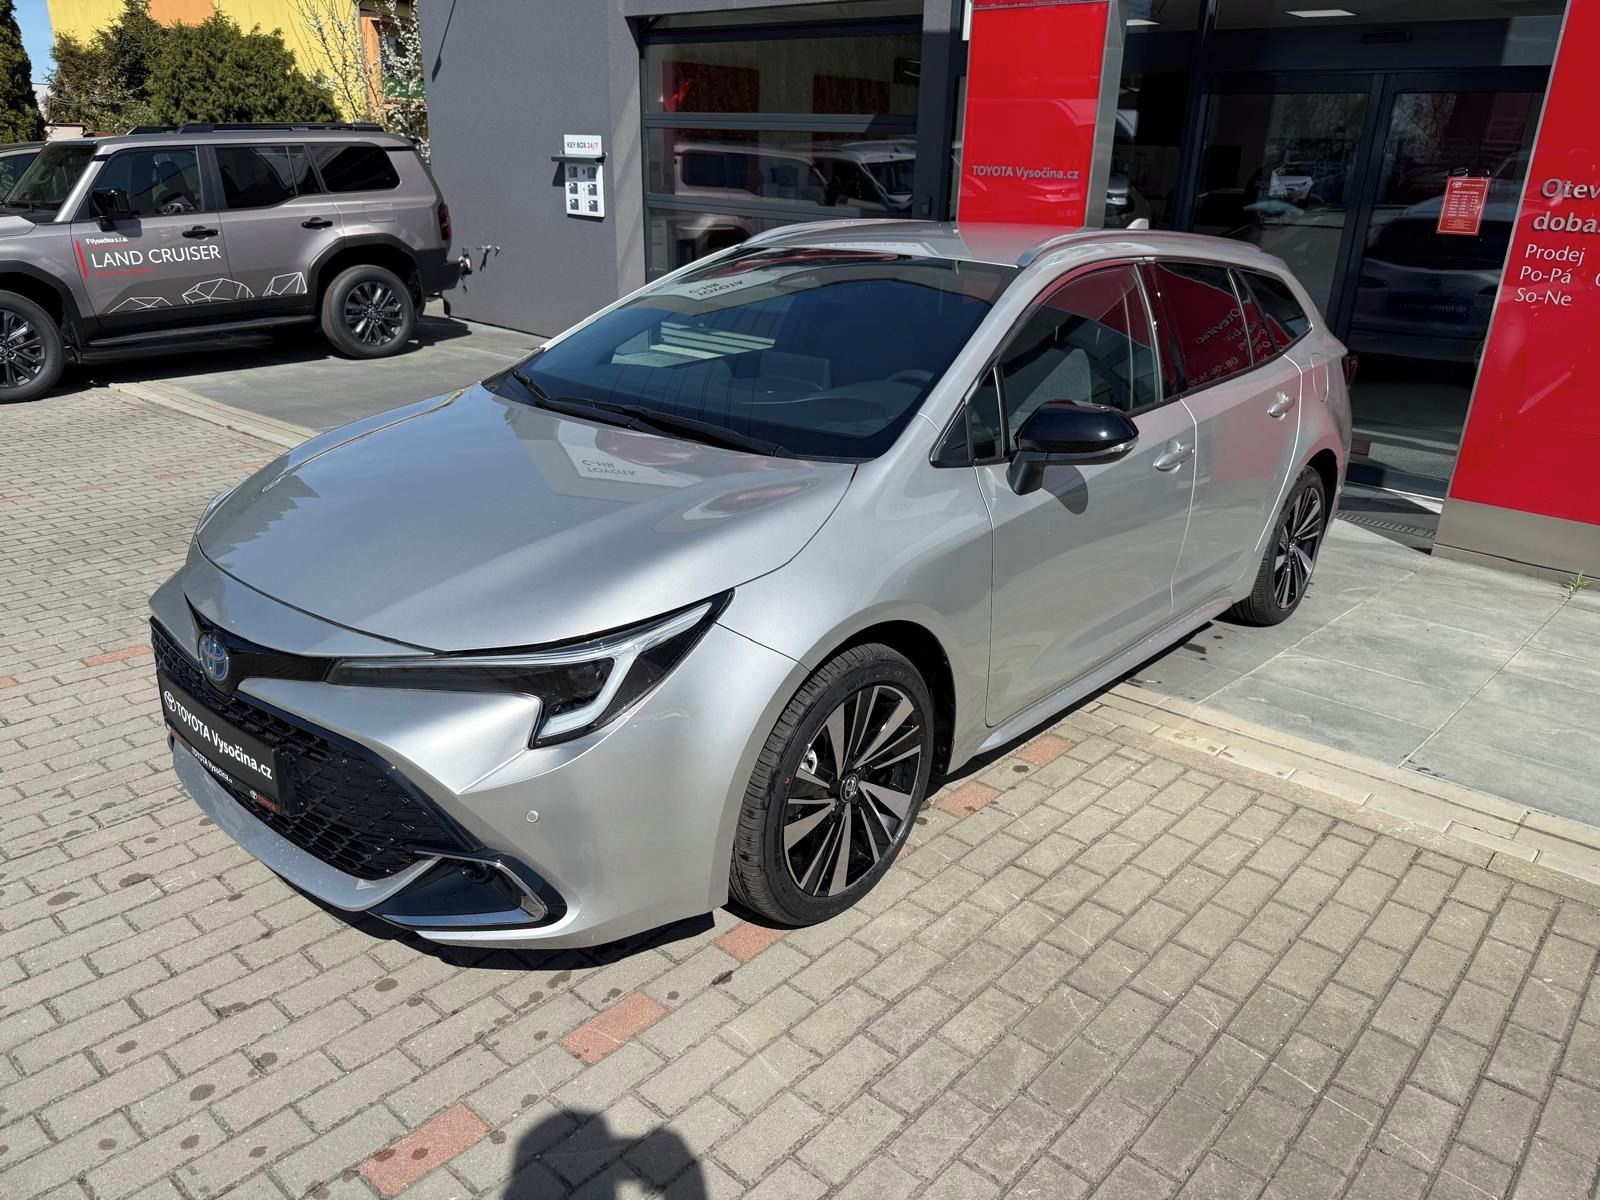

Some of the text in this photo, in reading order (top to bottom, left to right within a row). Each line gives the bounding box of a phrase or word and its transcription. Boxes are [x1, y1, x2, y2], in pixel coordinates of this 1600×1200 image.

[577, 141, 586, 149] BOX
[972, 165, 1080, 180] TOYOTA Vysočina.cz
[91, 244, 222, 268] LAND CRUISER
[1525, 244, 1586, 267] Prodej
[1520, 266, 1573, 284] Po-Pá
[1515, 287, 1573, 306] So-Ne
[175, 701, 273, 780] TOYOTA Vysočina.cz
